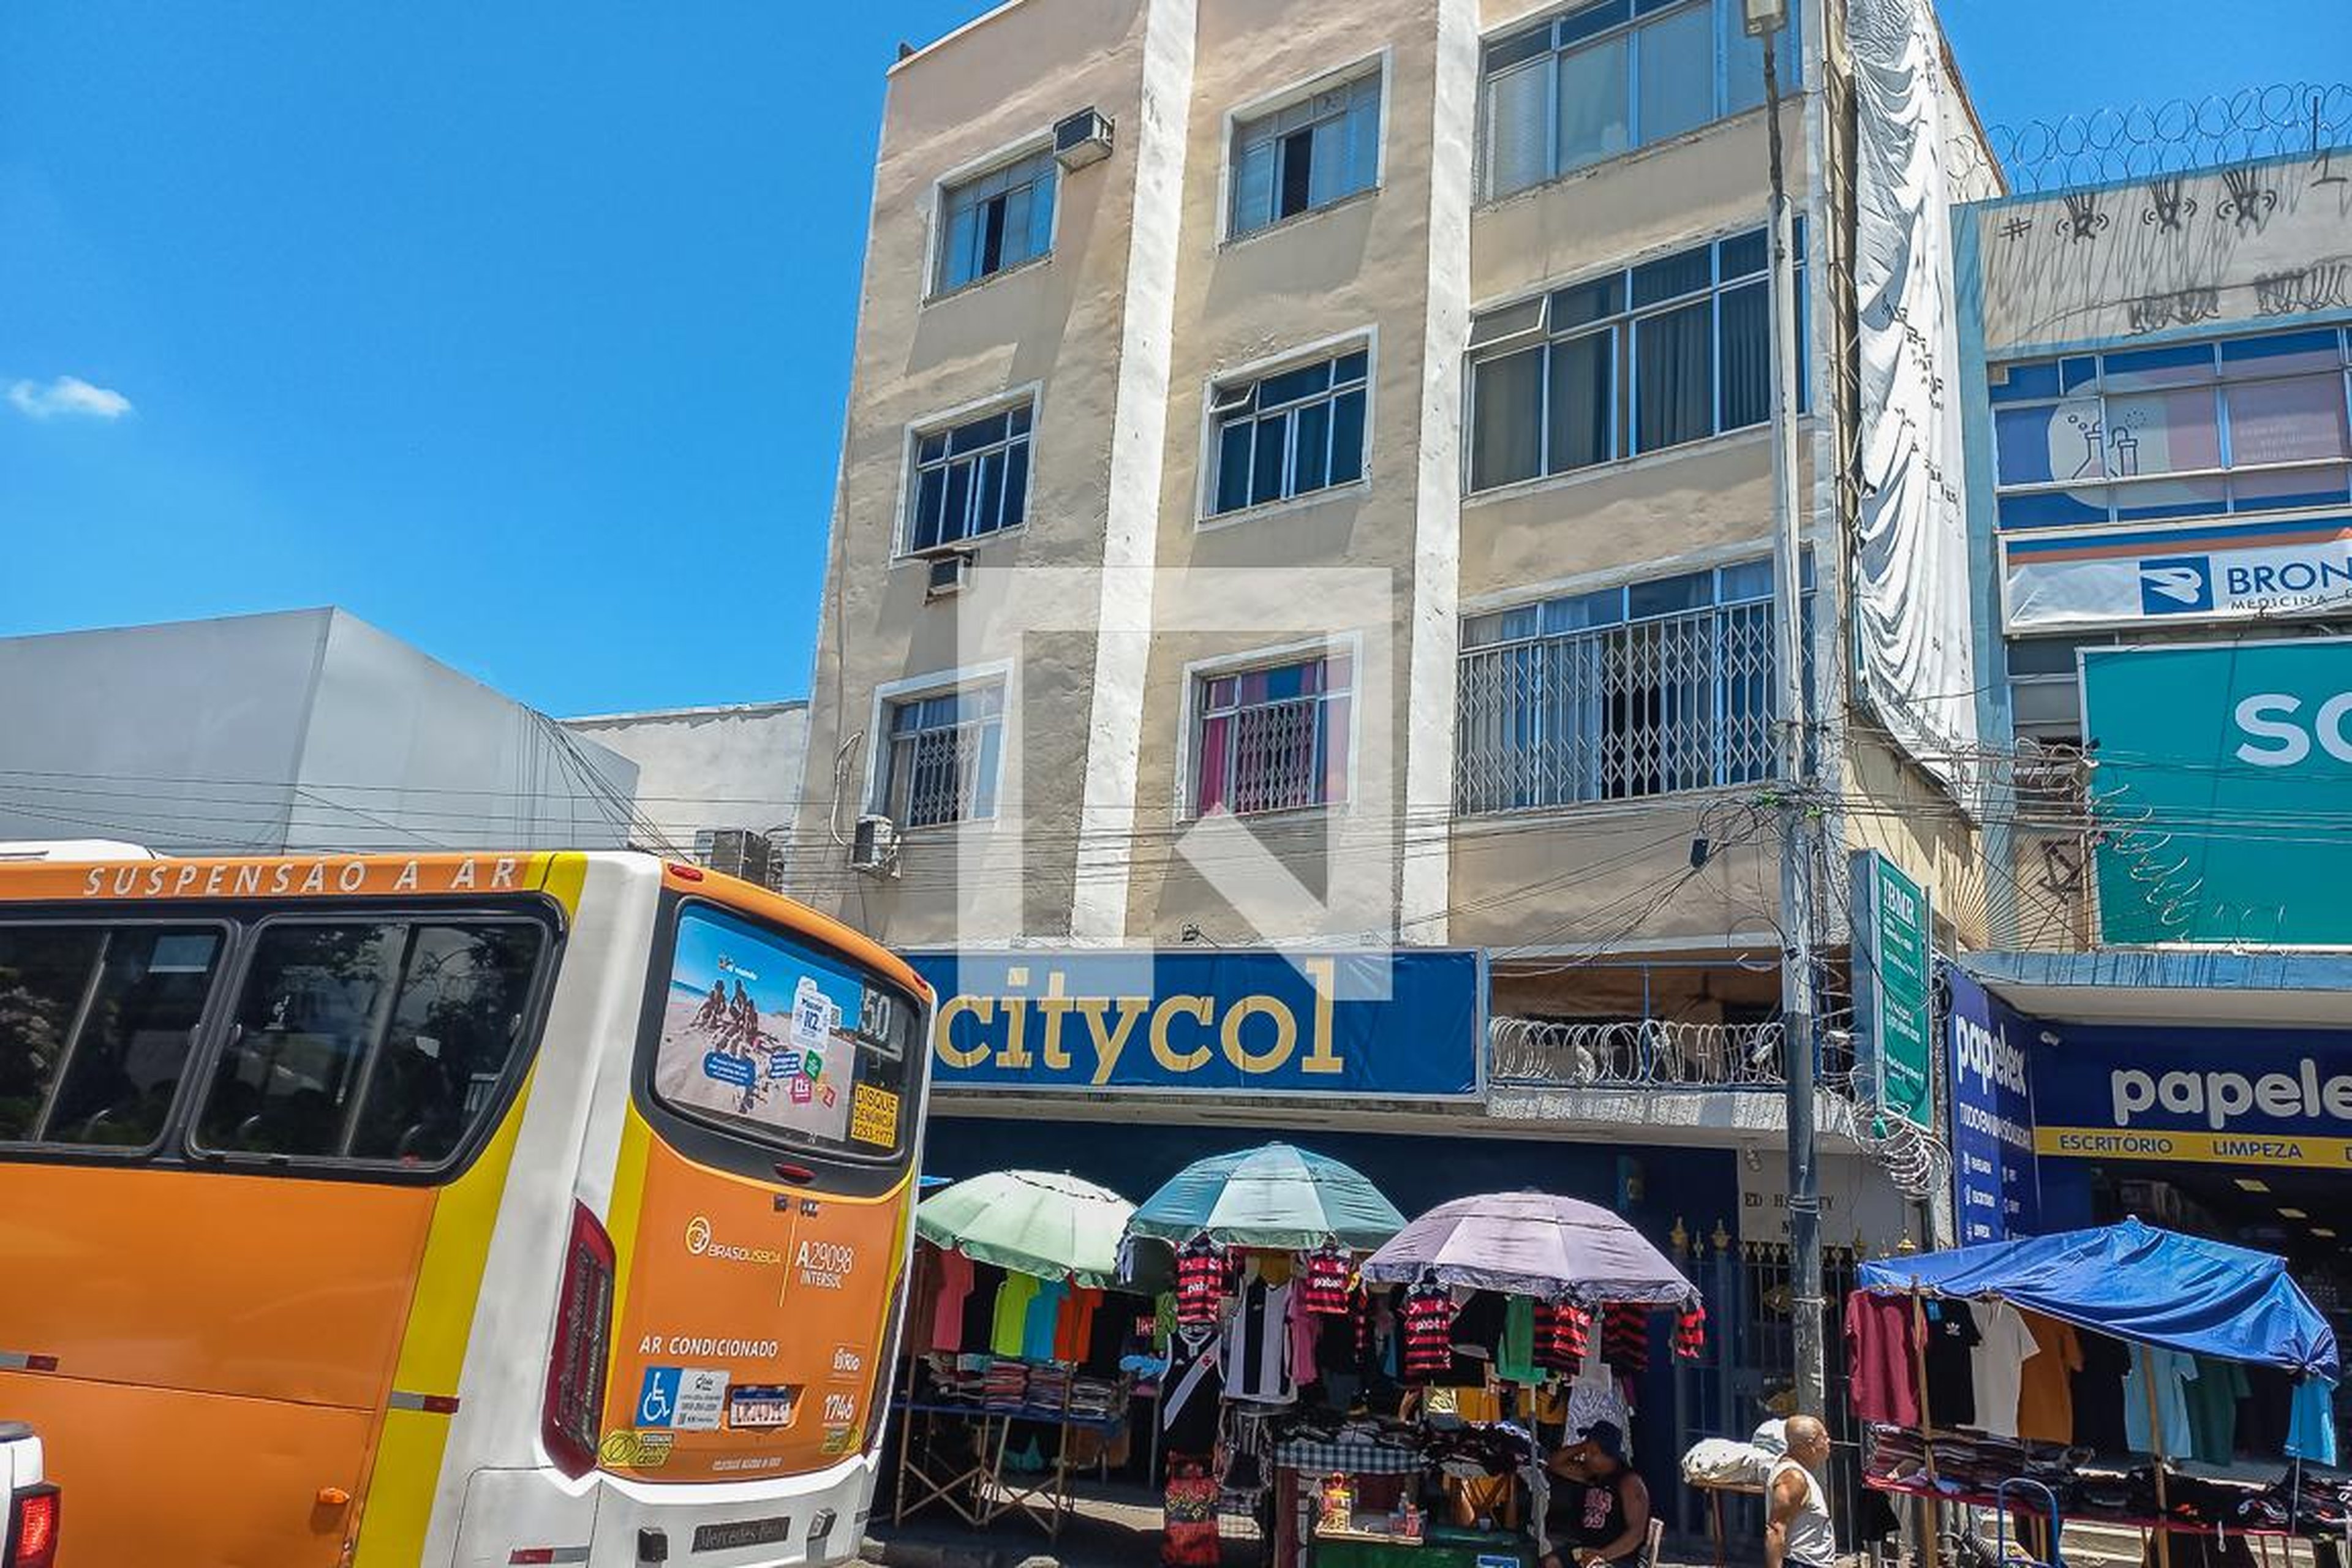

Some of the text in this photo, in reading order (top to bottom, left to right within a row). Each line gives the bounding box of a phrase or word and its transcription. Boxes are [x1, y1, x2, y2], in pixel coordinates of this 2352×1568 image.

[393, 861, 420, 891] A
[451, 858, 516, 890] AR
[933, 956, 1344, 1085] citycol
[1955, 1014, 2027, 1098] papelex
[2060, 1133, 2302, 1159] ESCRITÓRIO LIMPEZA
[638, 1335, 779, 1358] AR CONDICIONADO
